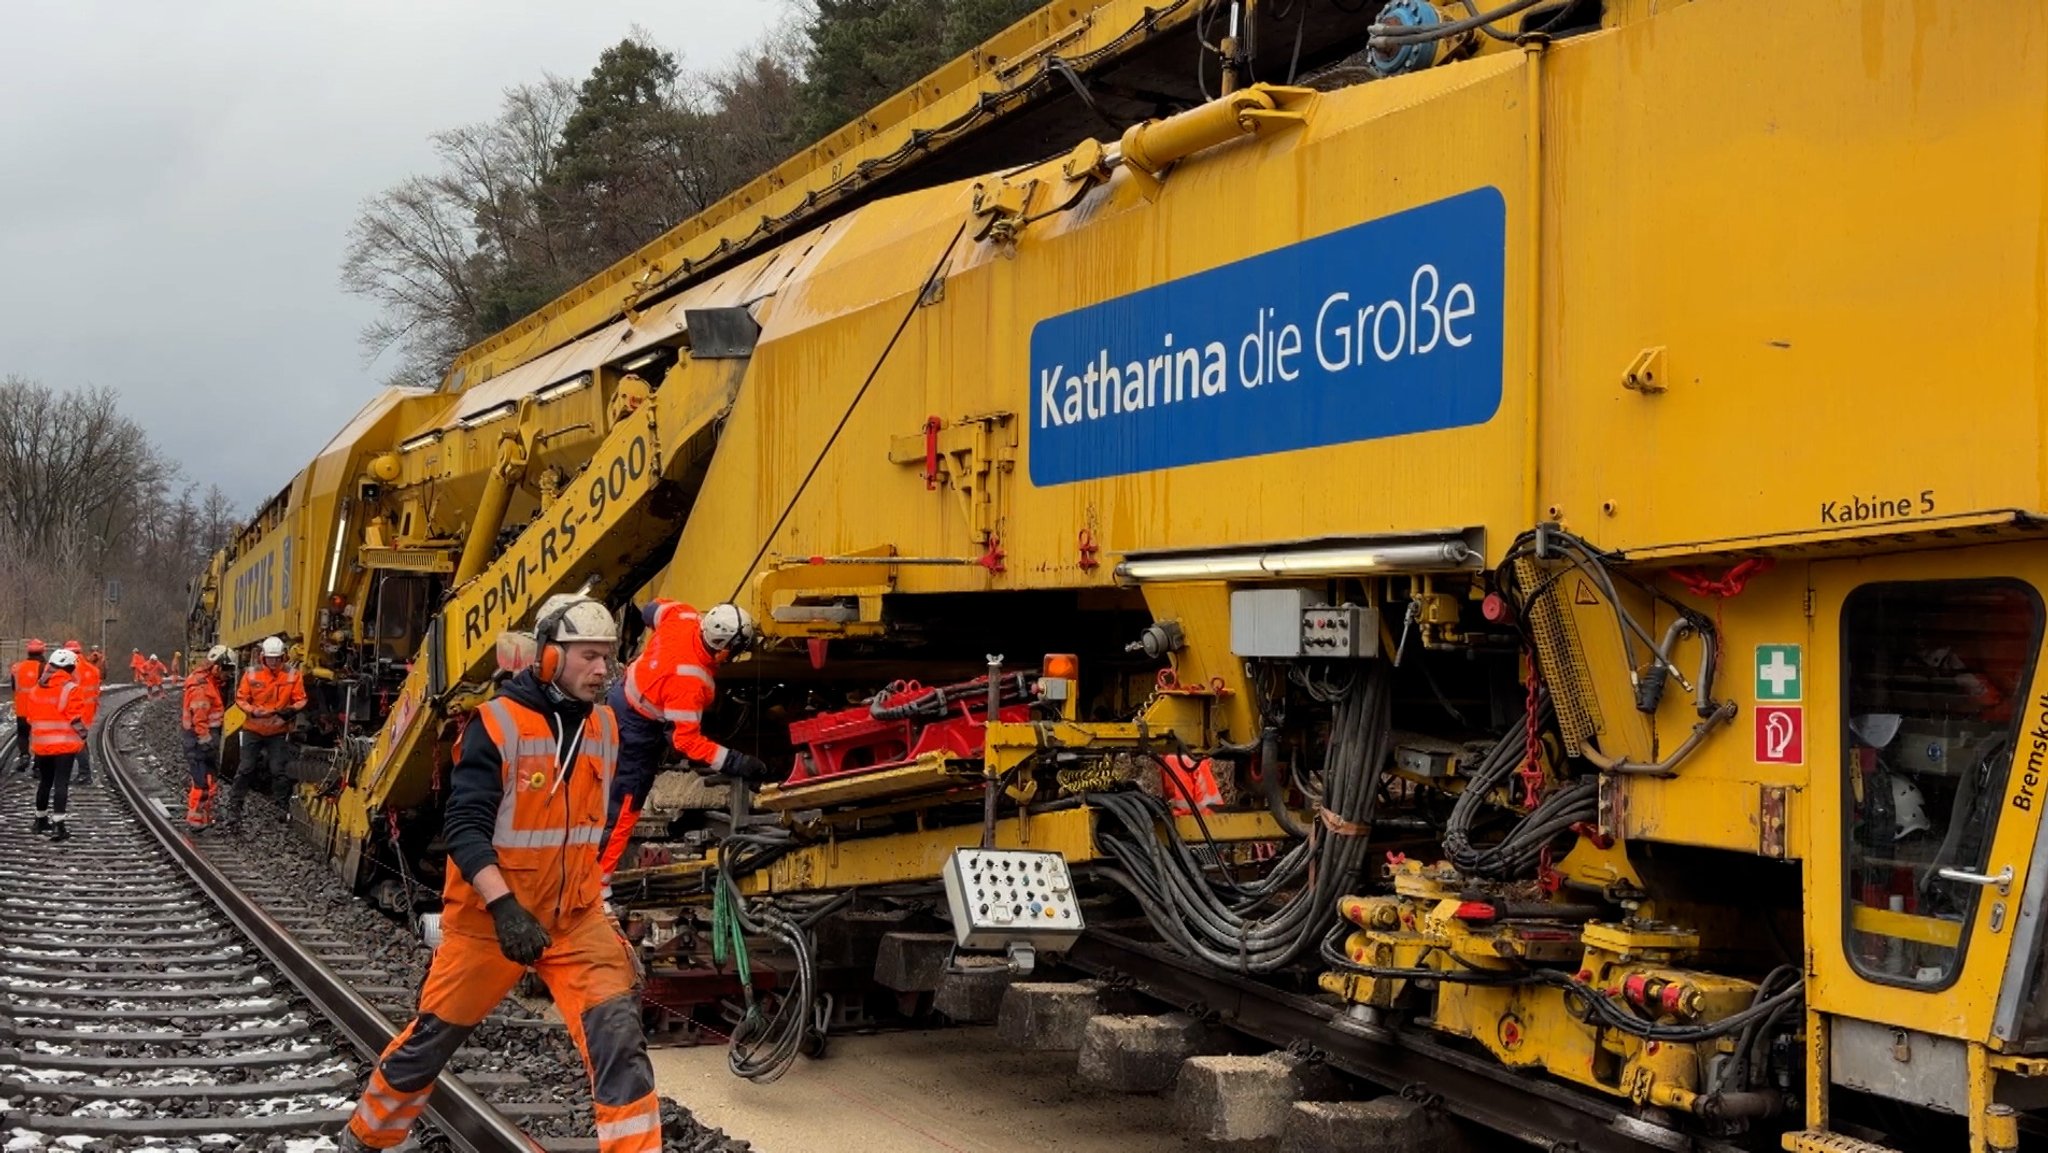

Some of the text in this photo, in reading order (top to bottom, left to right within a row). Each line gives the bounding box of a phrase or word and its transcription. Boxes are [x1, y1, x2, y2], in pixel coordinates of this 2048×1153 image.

[1040, 263, 1476, 428] Katharina die Große
[464, 435, 647, 650] RPM-RS-900
[1821, 489, 1935, 523] Kabine 5
[233, 550, 276, 632] SPITZKE
